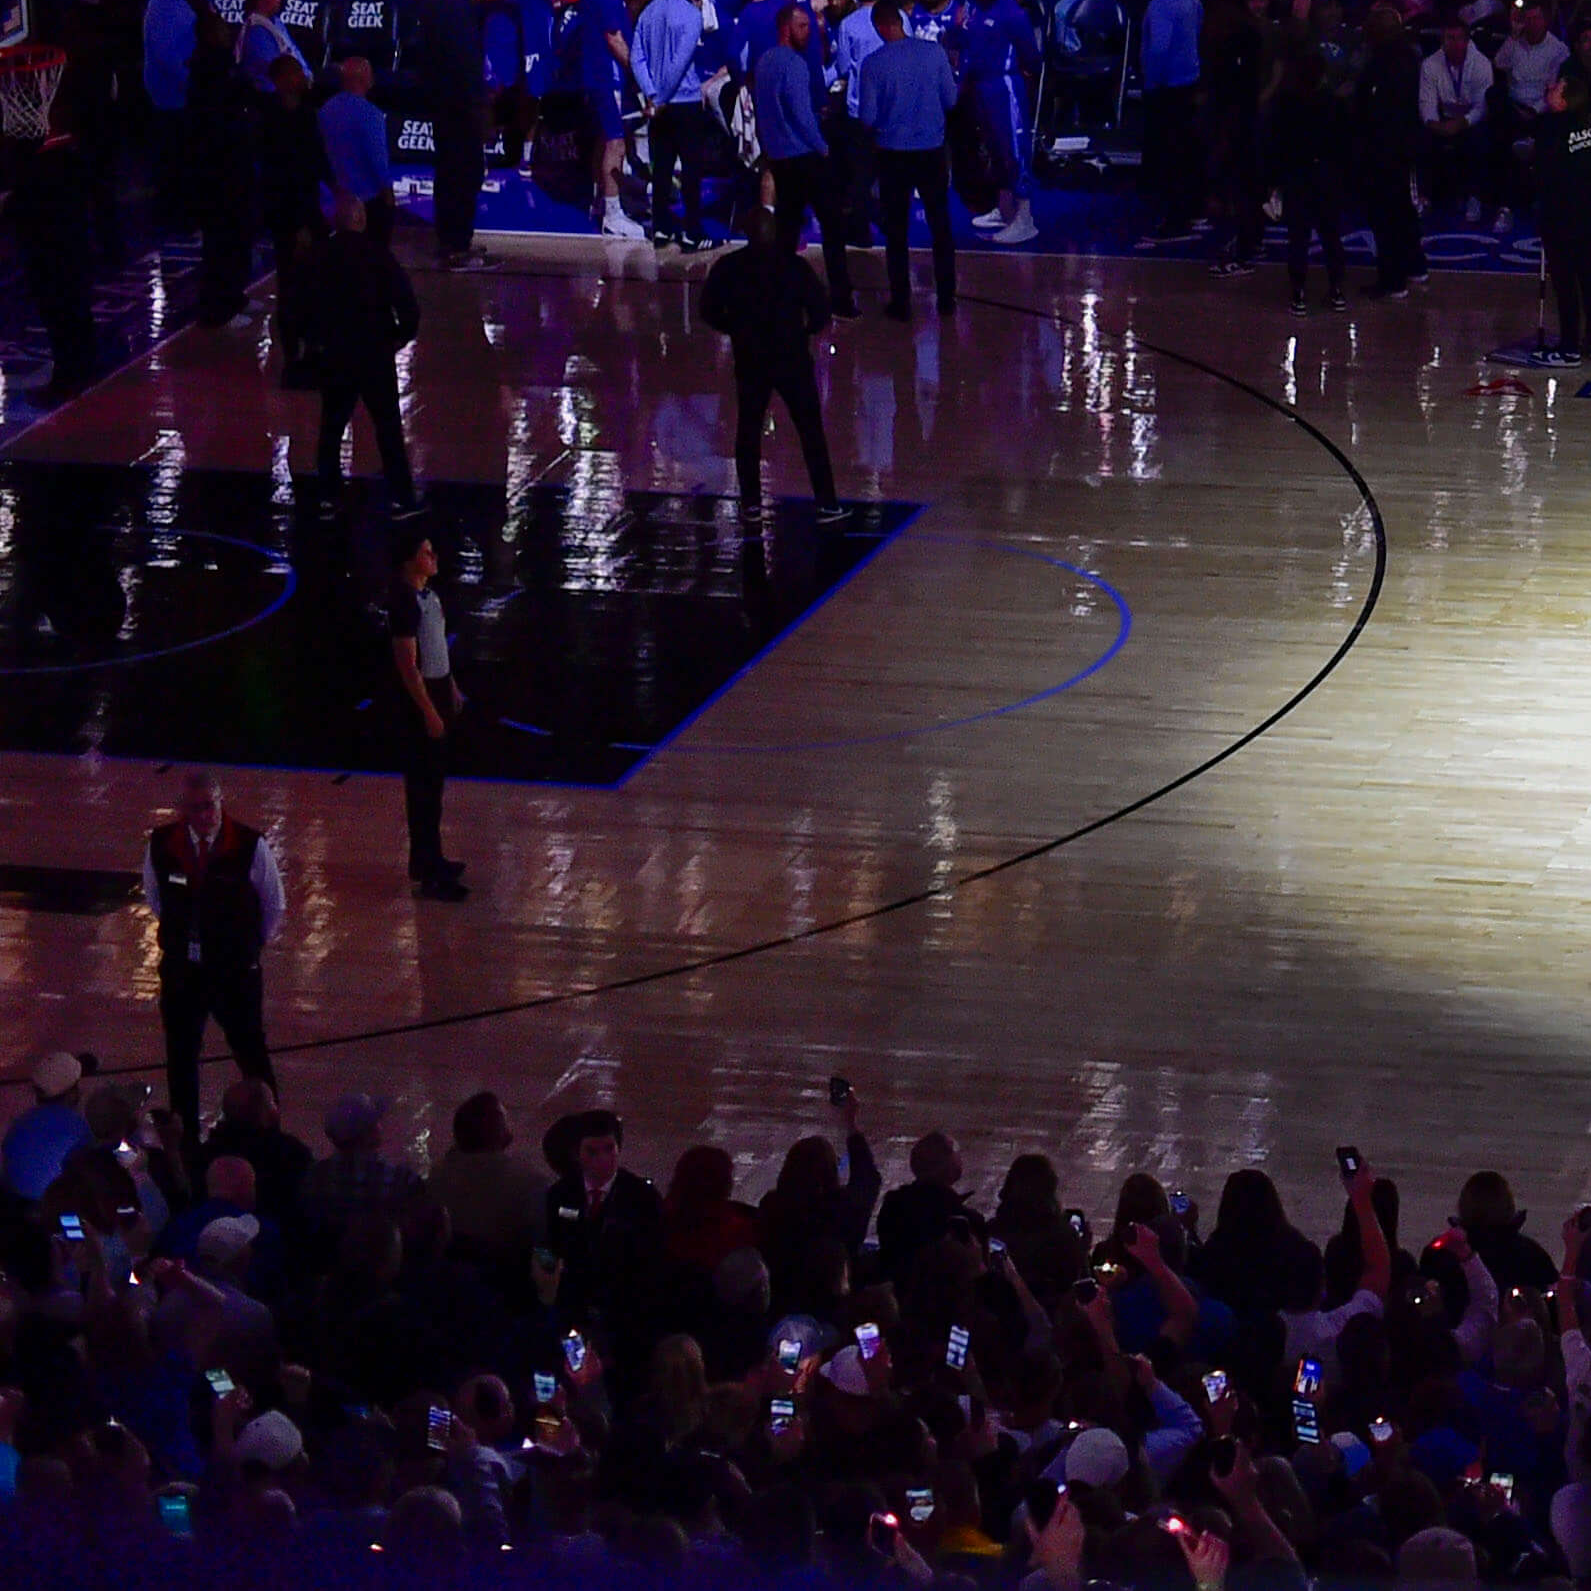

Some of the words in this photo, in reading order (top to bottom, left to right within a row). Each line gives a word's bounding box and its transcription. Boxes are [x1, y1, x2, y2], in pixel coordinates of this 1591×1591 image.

[351, 1, 384, 16] SEAT
[280, 11, 315, 29] GEEK
[347, 15, 383, 29] GEEK
